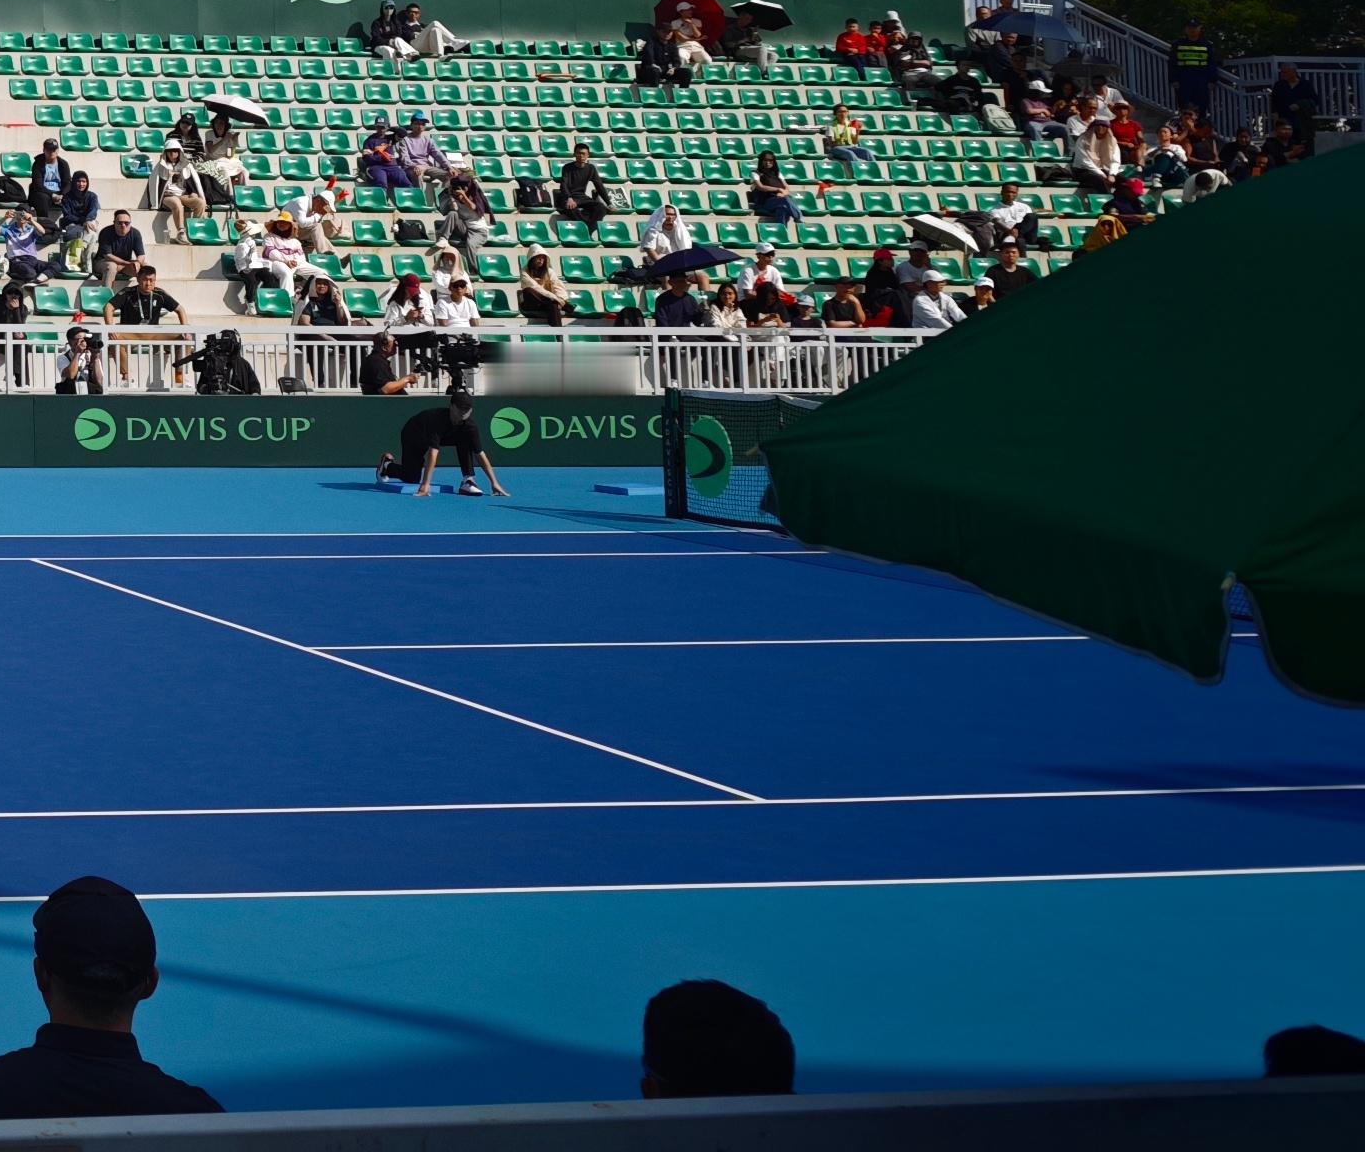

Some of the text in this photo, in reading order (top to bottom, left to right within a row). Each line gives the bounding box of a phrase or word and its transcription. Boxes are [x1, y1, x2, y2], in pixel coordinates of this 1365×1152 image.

[126, 416, 312, 442] DAVIS CUP
[540, 414, 637, 440] DAVIS
